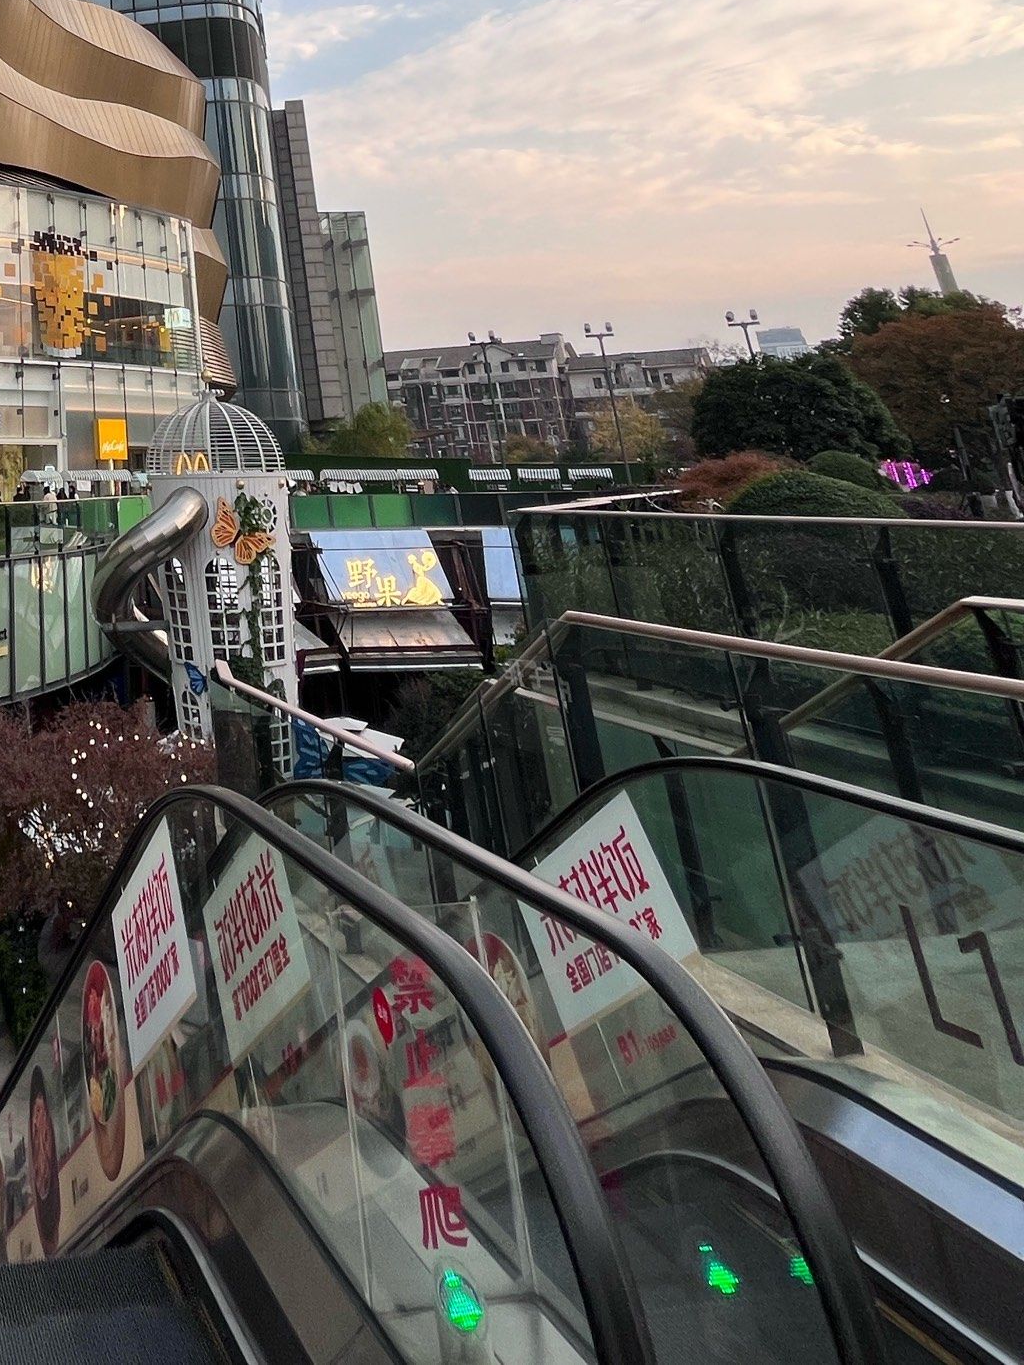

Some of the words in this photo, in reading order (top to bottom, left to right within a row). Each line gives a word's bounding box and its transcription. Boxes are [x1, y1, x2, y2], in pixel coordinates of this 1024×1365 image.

[346, 558, 402, 607] 野果
[121, 852, 175, 990] 米村拌饭
